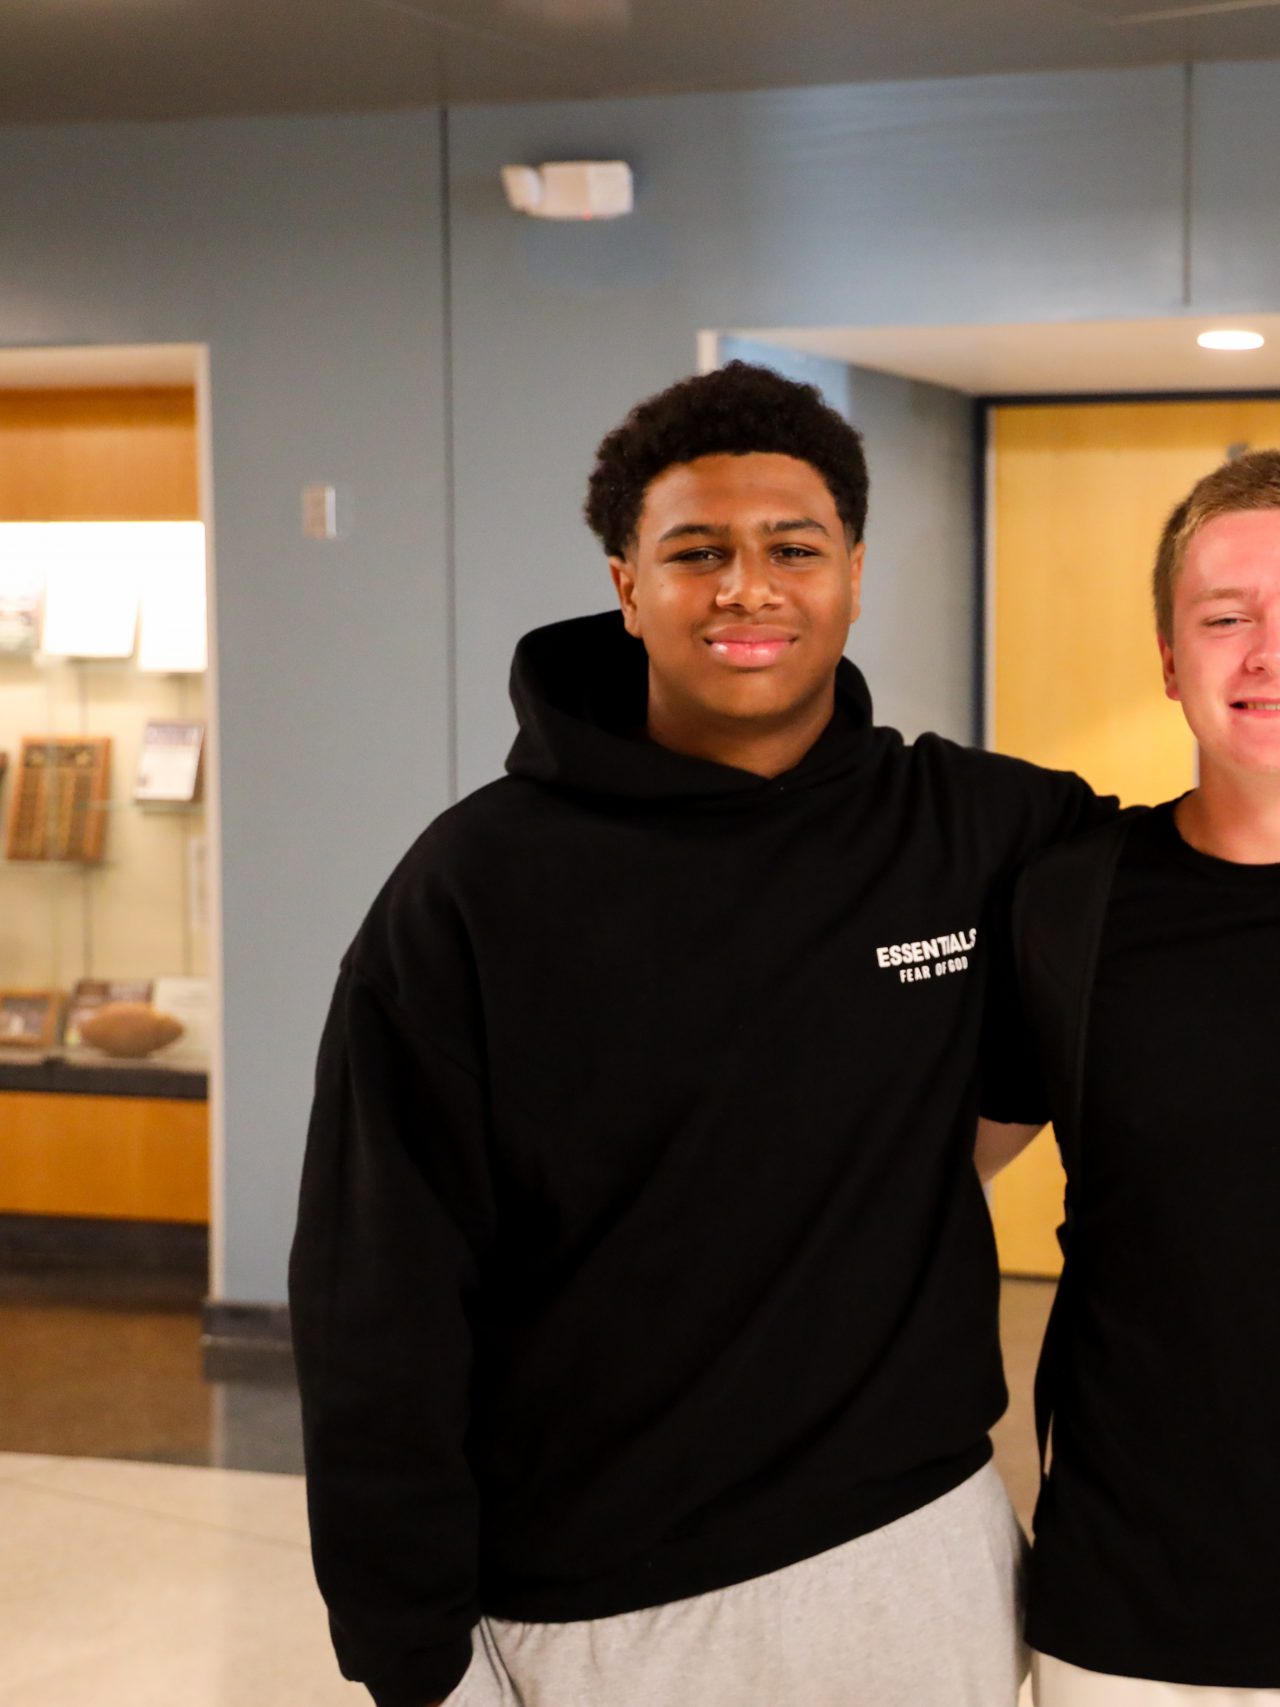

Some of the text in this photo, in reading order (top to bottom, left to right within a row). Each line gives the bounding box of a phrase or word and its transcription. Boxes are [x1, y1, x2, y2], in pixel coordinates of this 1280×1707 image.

[900, 956, 968, 983] FEAR OF GOD
